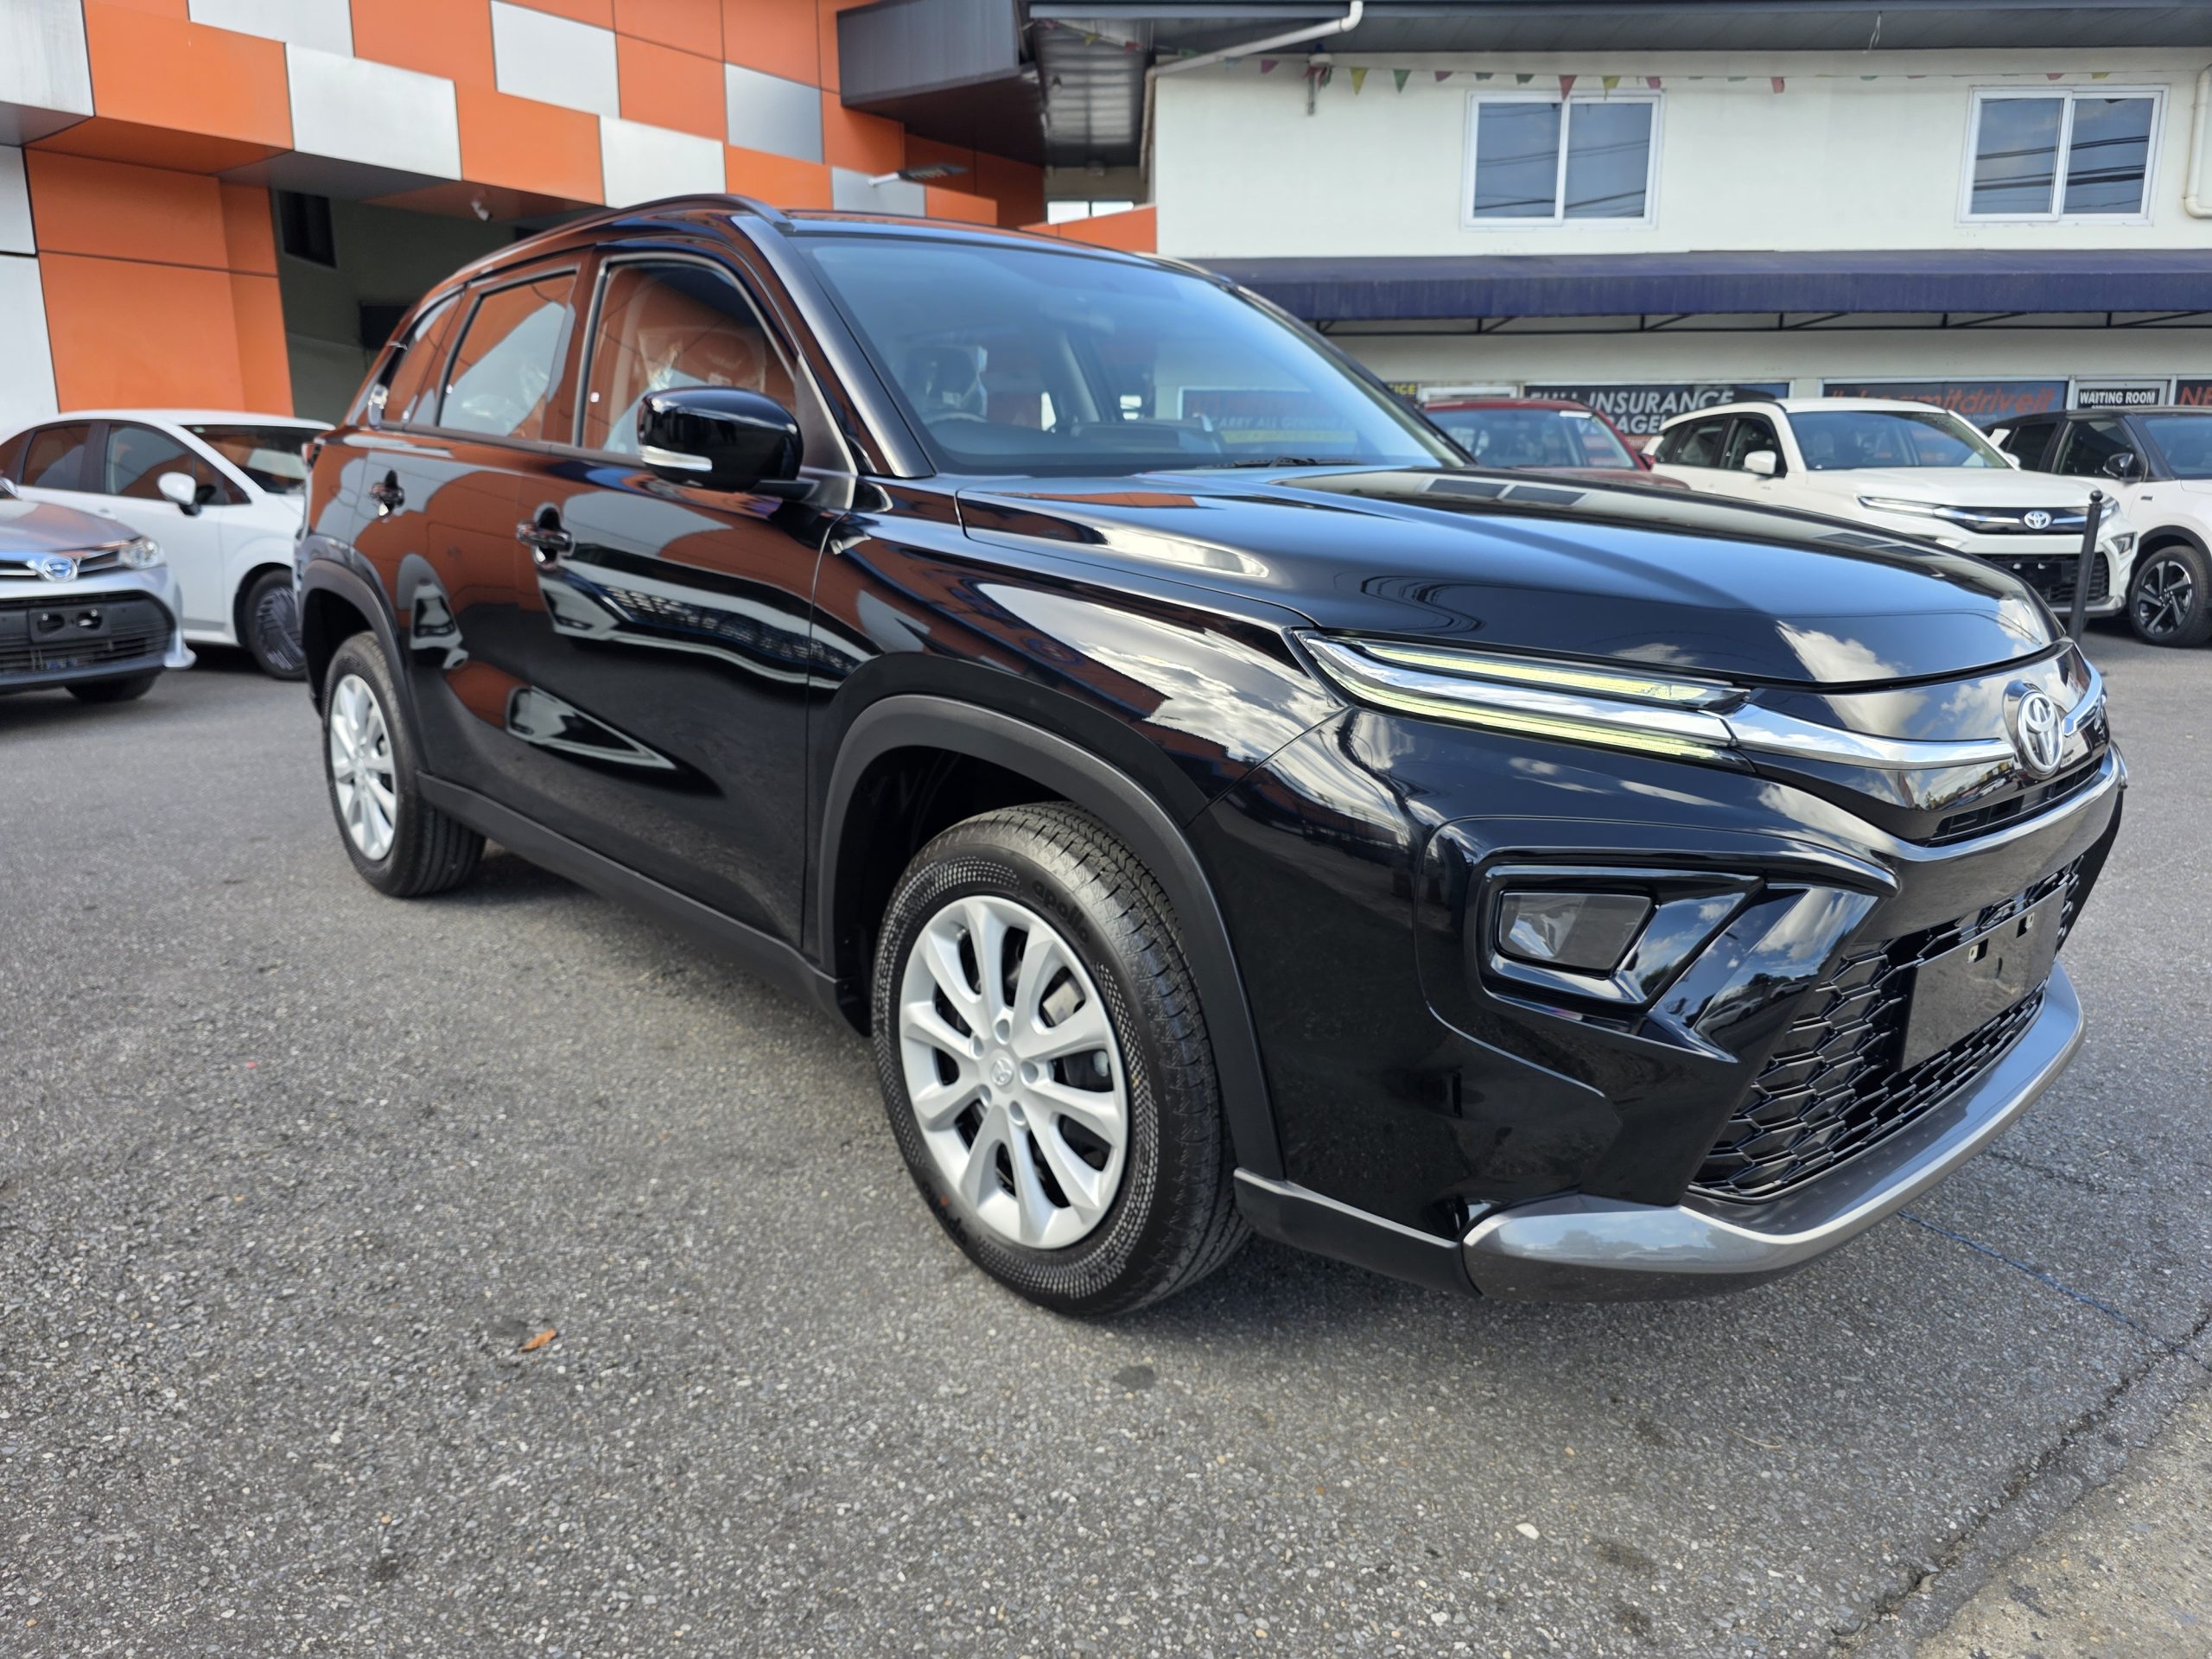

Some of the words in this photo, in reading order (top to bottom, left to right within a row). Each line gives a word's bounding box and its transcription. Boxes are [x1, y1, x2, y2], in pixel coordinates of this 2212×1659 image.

[1588, 391, 1734, 414] INSURANCE
[2080, 391, 2123, 404] WAITING
[2125, 391, 2156, 404] ROOM
[1032, 879, 1090, 944] apollo
